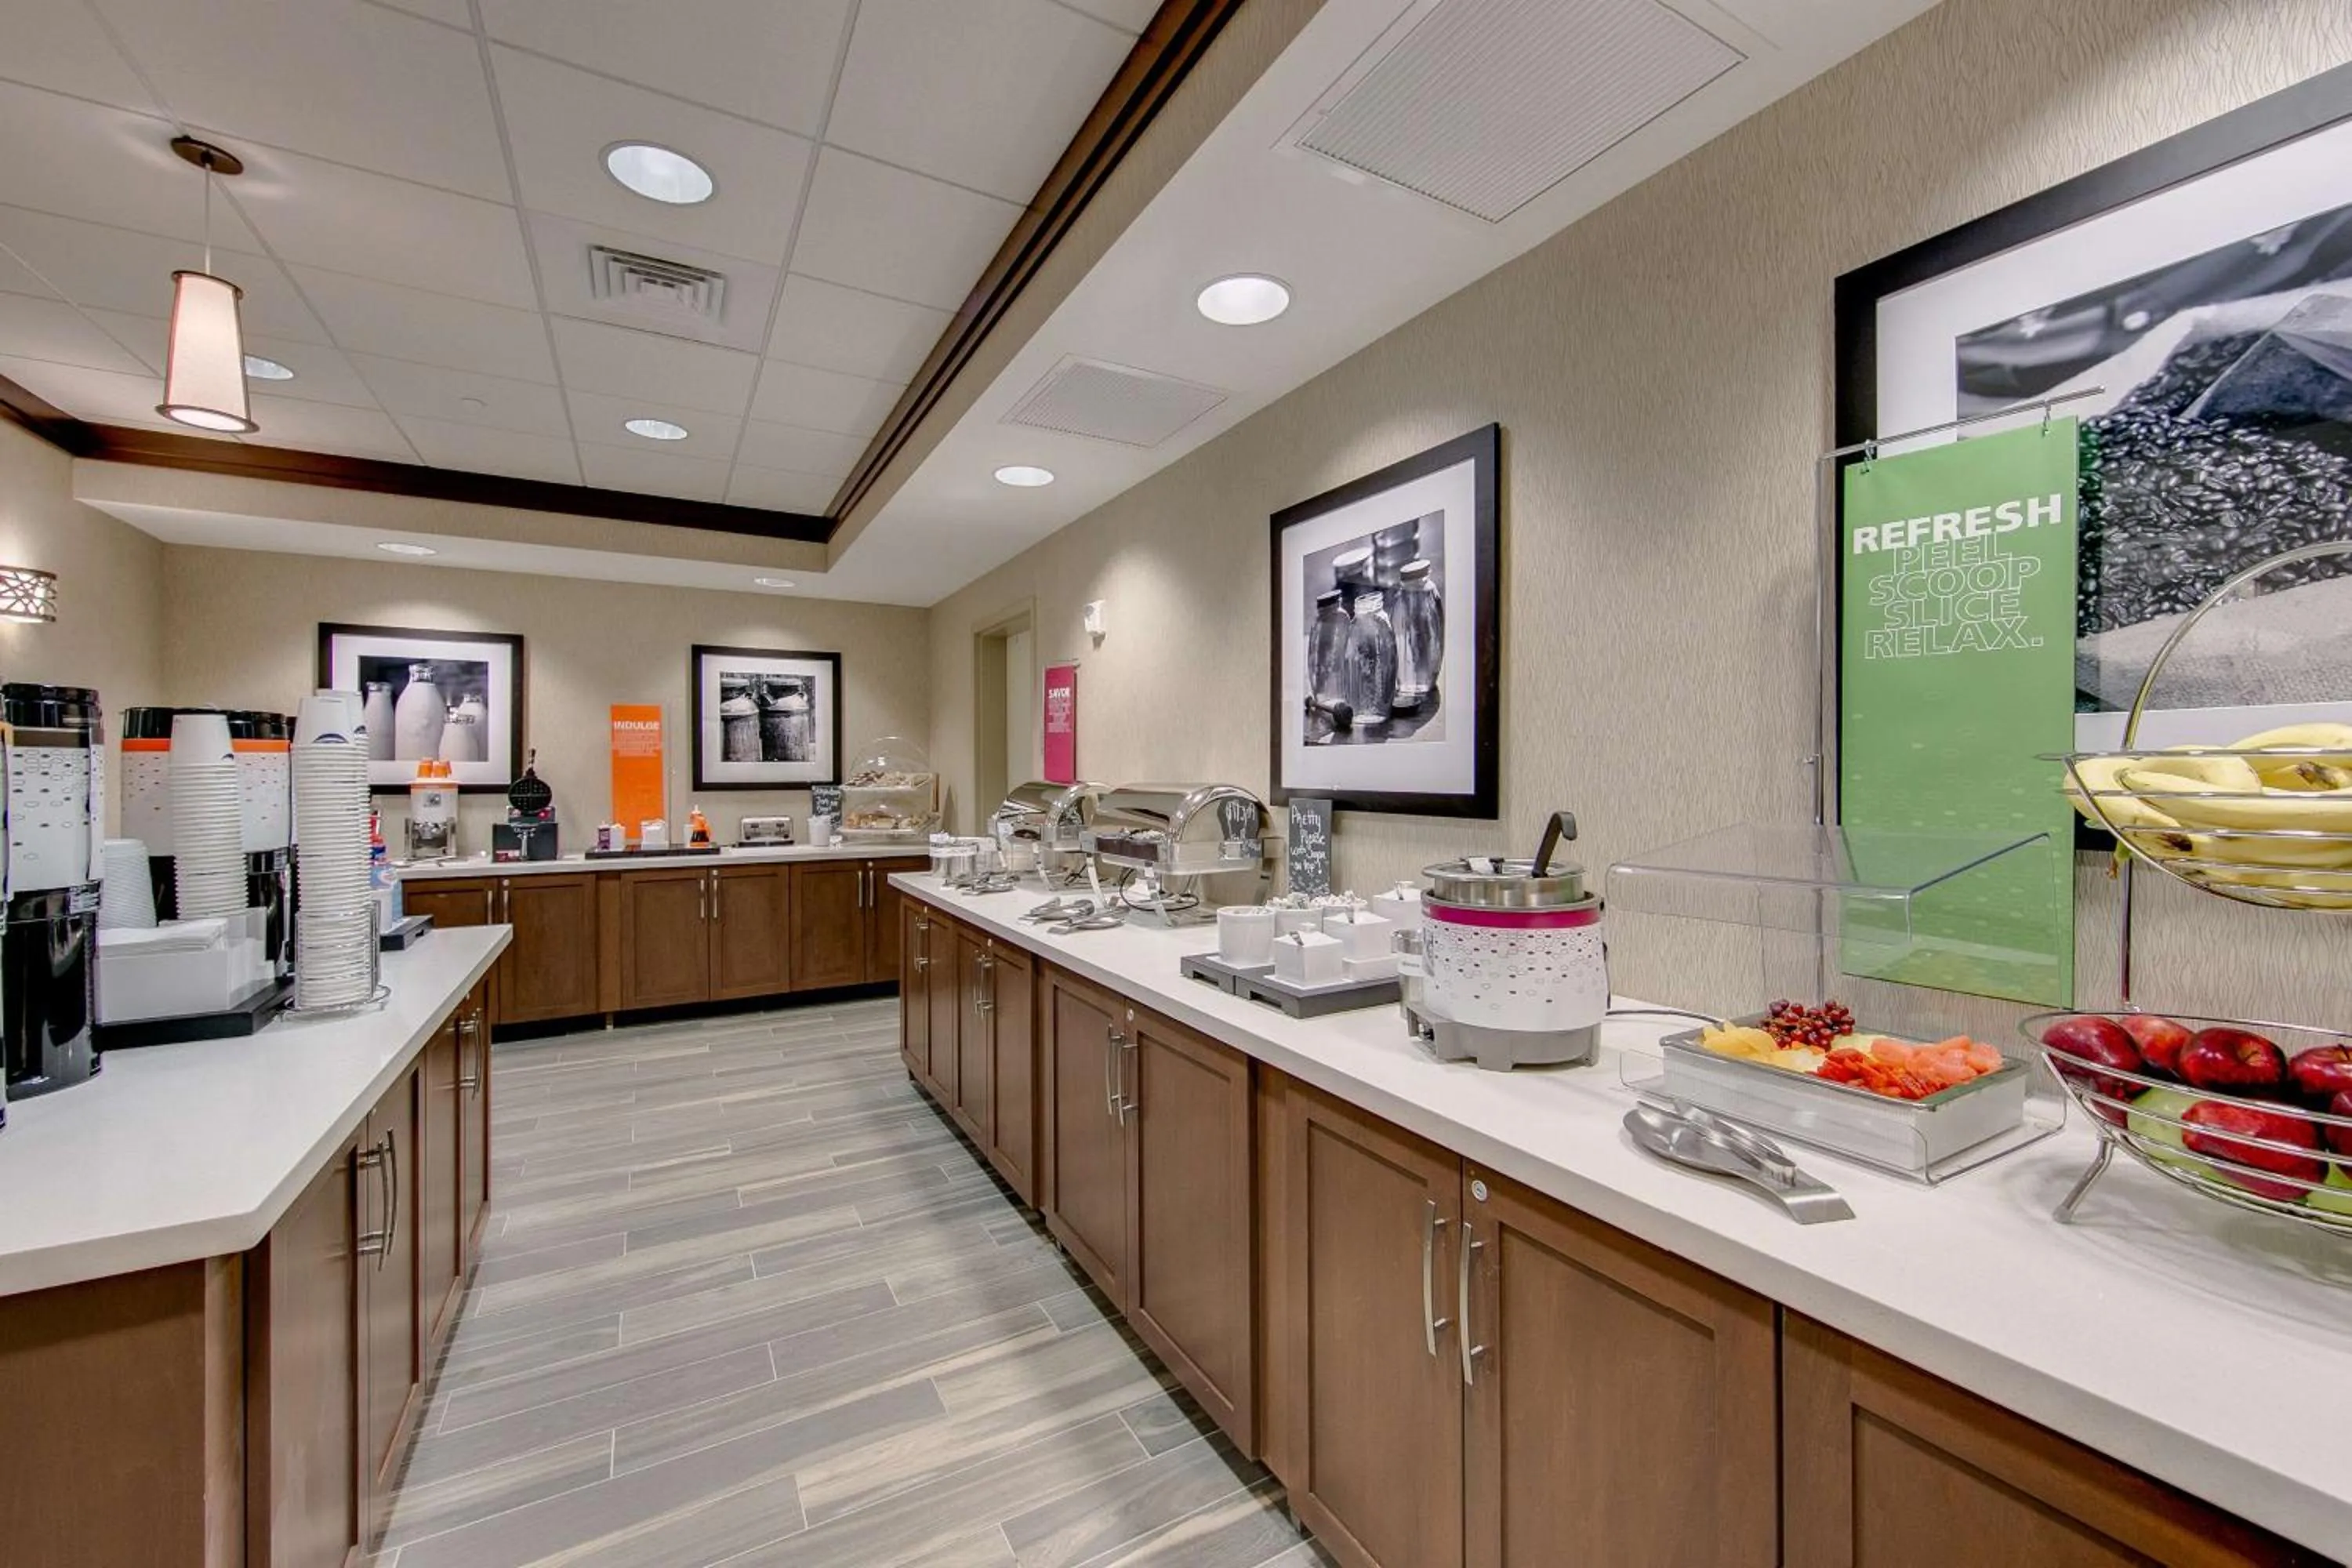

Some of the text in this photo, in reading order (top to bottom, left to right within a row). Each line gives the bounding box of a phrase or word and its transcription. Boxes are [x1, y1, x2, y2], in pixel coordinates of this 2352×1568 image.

[1853, 493, 2062, 555] REFRESH
[1893, 532, 2012, 575] PEEL
[1868, 556, 2042, 606] SCOOP
[1884, 589, 2021, 630] SLICE
[1864, 615, 2044, 660] RELAX.
[614, 720, 660, 731] INDULGE
